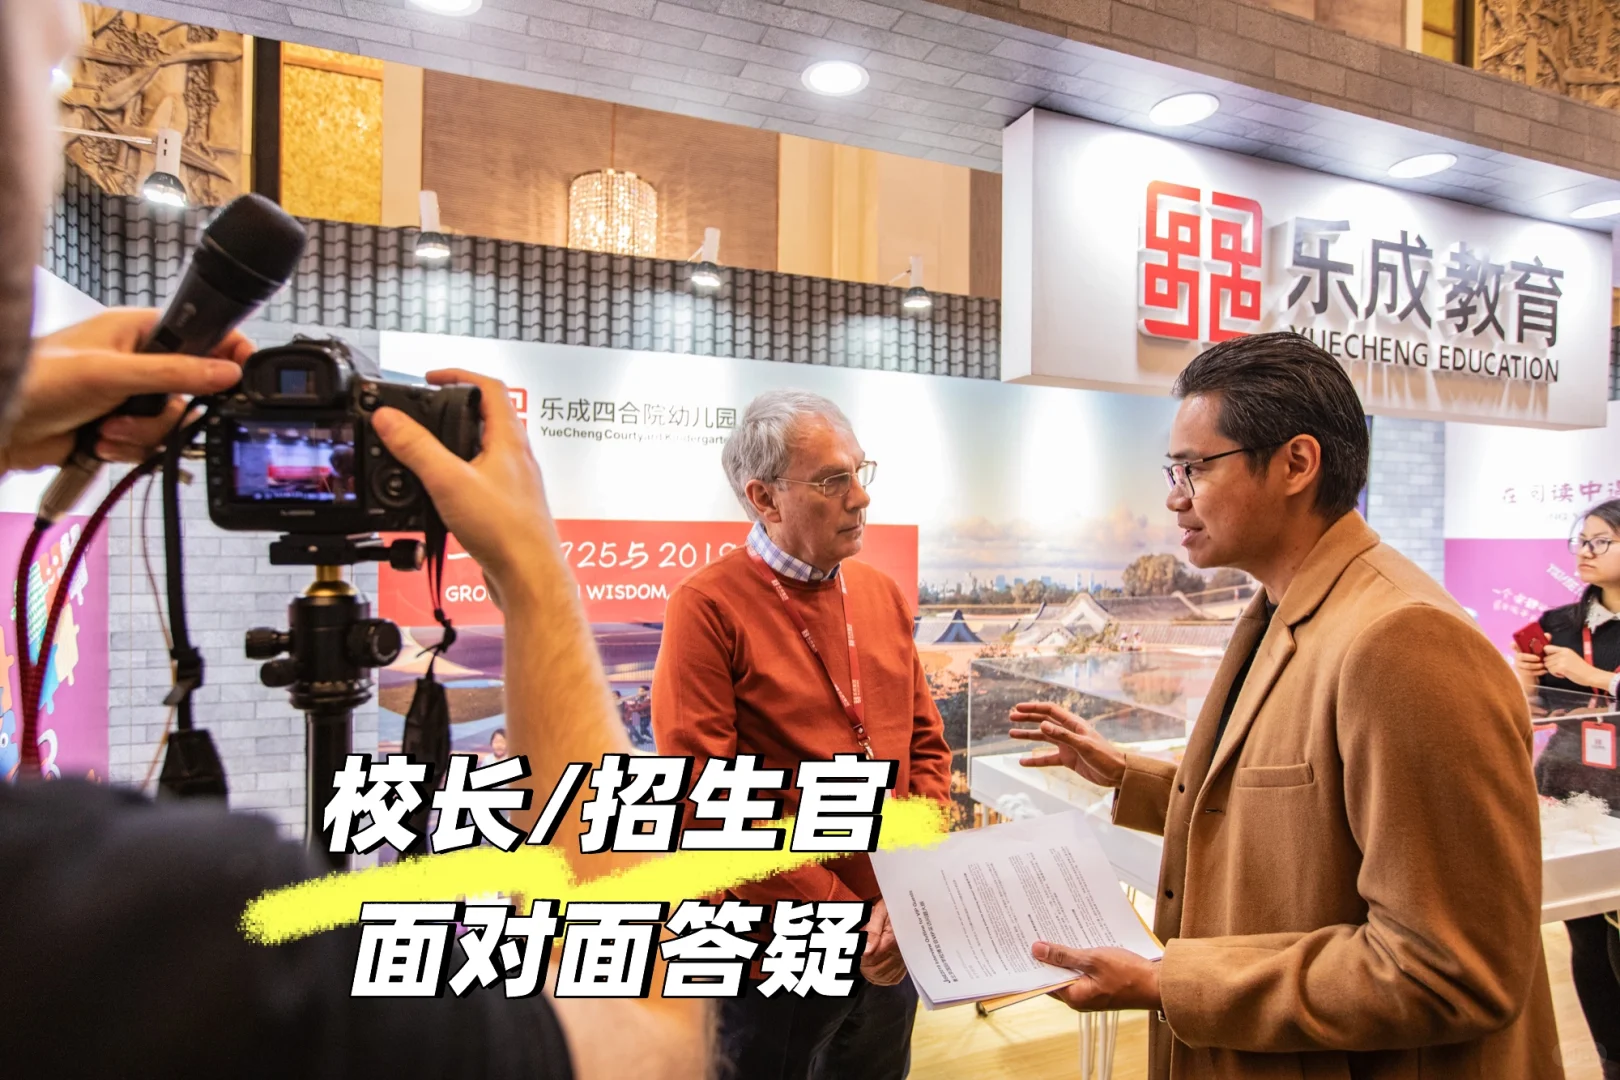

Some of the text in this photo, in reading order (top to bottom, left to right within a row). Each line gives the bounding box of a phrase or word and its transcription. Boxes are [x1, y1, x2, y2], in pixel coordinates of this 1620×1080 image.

[1287, 218, 1563, 347] 乐成教育
[1439, 345, 1559, 382] EDUCATION
[540, 397, 736, 429] 乐成四合院幼儿园
[540, 427, 602, 442] YueCheng
